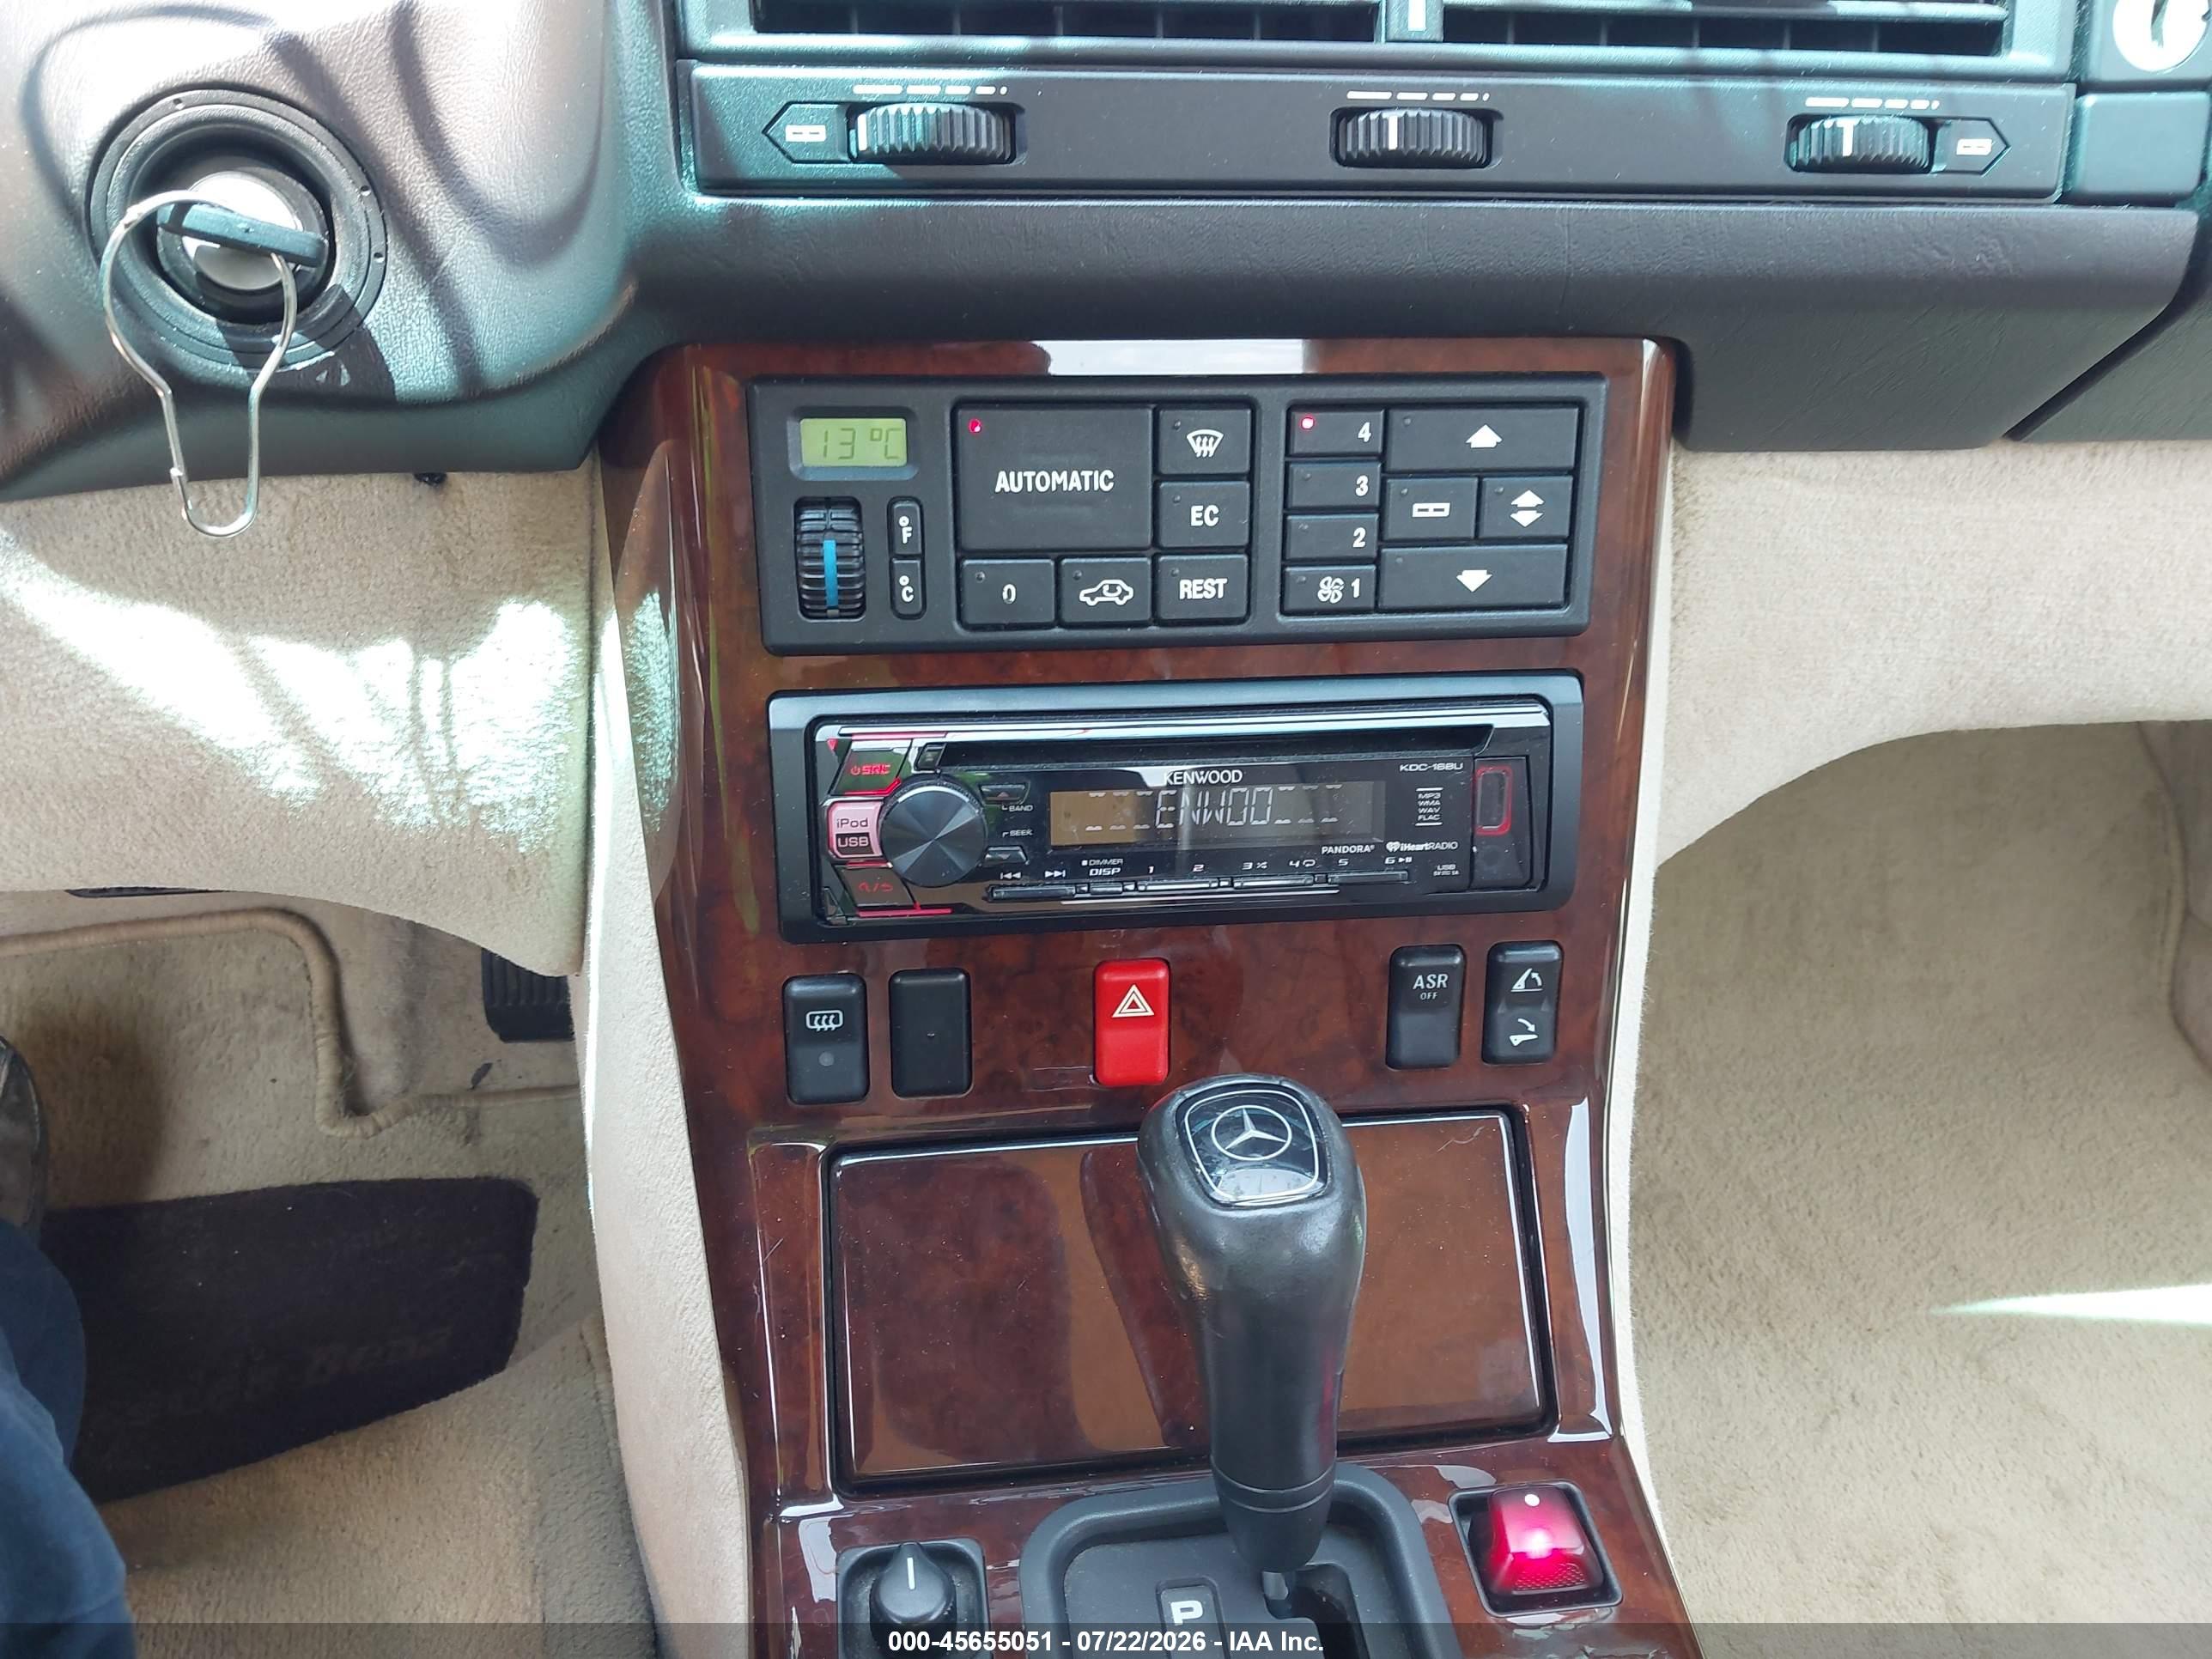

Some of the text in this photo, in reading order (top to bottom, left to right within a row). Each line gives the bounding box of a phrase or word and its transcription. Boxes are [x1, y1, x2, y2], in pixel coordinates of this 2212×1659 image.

[1358, 422, 1372, 442] 4
[994, 469, 1115, 493] AUTOMATIC
[1355, 475, 1369, 496] 3
[1190, 504, 1219, 526] EC
[1352, 526, 1366, 548] 2
[1179, 578, 1228, 599] REST
[1351, 578, 1360, 599] 1
[1164, 769, 1243, 786] KENWOOD
[836, 817, 869, 829] iPod
[837, 836, 869, 848] USB
[1088, 858, 1124, 866] DIMMER
[1193, 864, 1205, 872] 2
[1338, 858, 1349, 866] 5
[1384, 856, 1395, 865] 6
[1089, 867, 1121, 876] DISP
[1149, 866, 1154, 874] 1
[1413, 973, 1449, 990] ASR
[1419, 991, 1437, 1000] OFF
[1169, 1600, 1204, 1626] P
